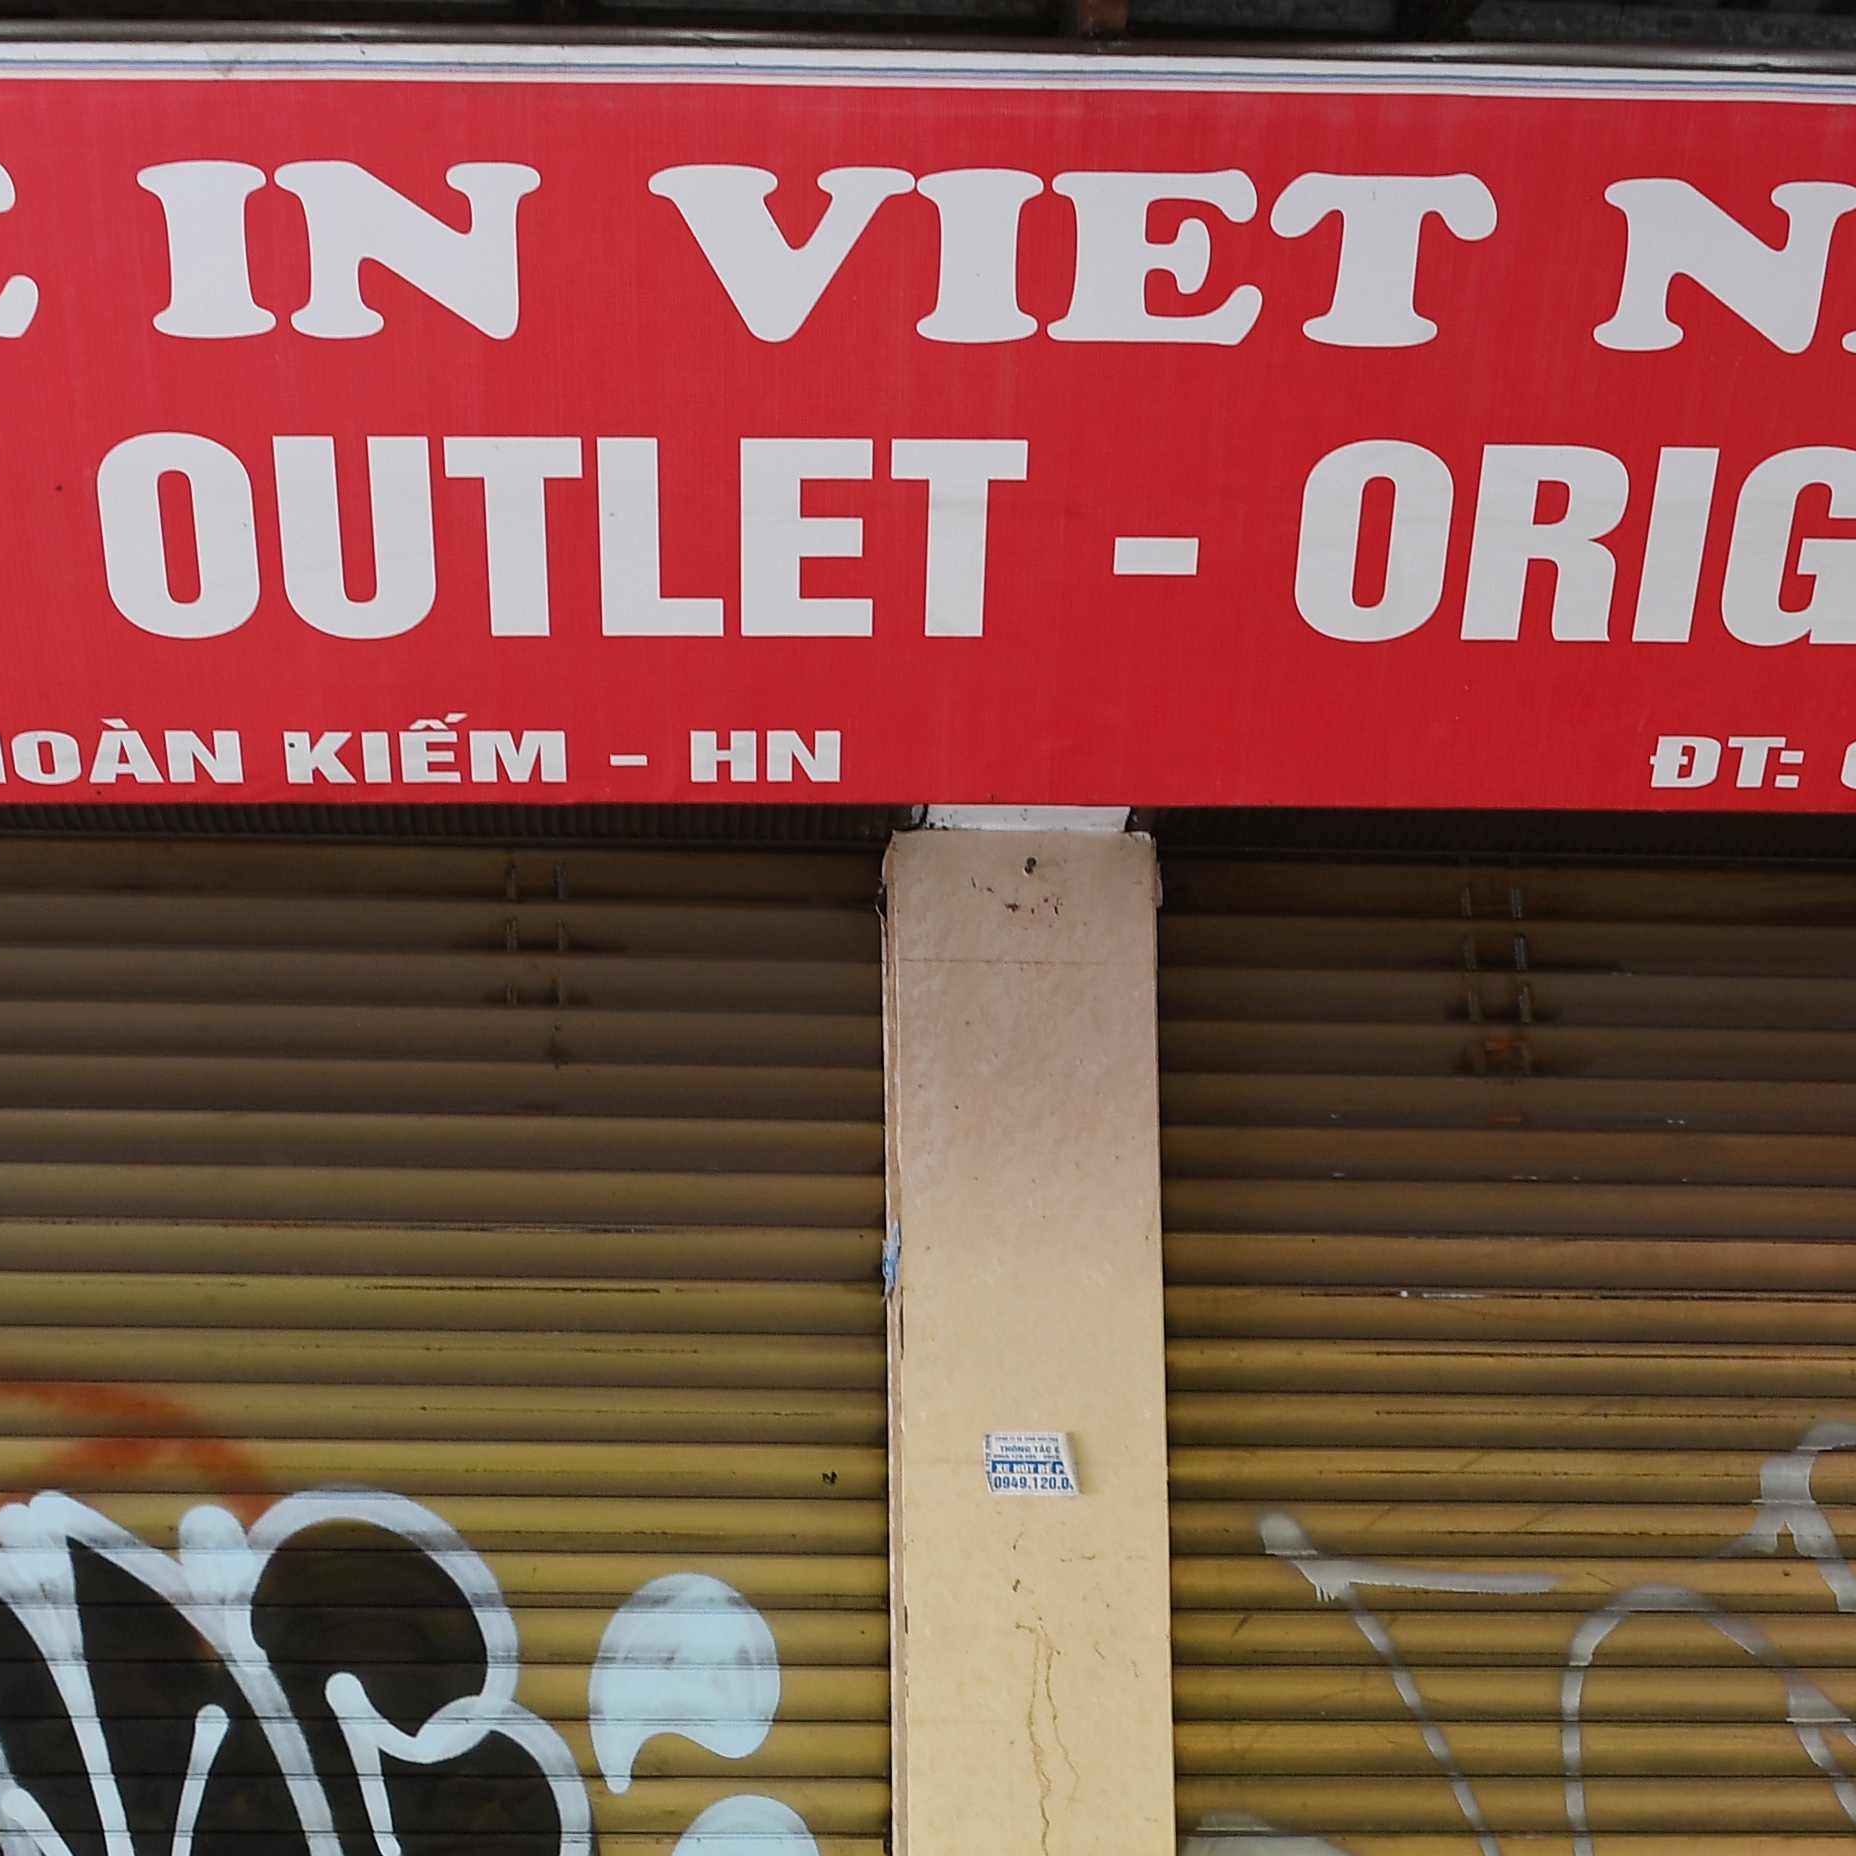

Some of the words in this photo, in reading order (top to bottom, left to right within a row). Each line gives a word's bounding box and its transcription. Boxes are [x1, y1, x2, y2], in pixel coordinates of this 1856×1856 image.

[137, 160, 540, 339] IN
[648, 165, 1497, 347] VIET
[97, 432, 1028, 639] OUTLET
[284, 713, 566, 783] KIẾM
[691, 731, 840, 782] HN
[1650, 736, 1804, 788] ĐT:
[994, 1475, 1073, 1490] 0949.120.0
